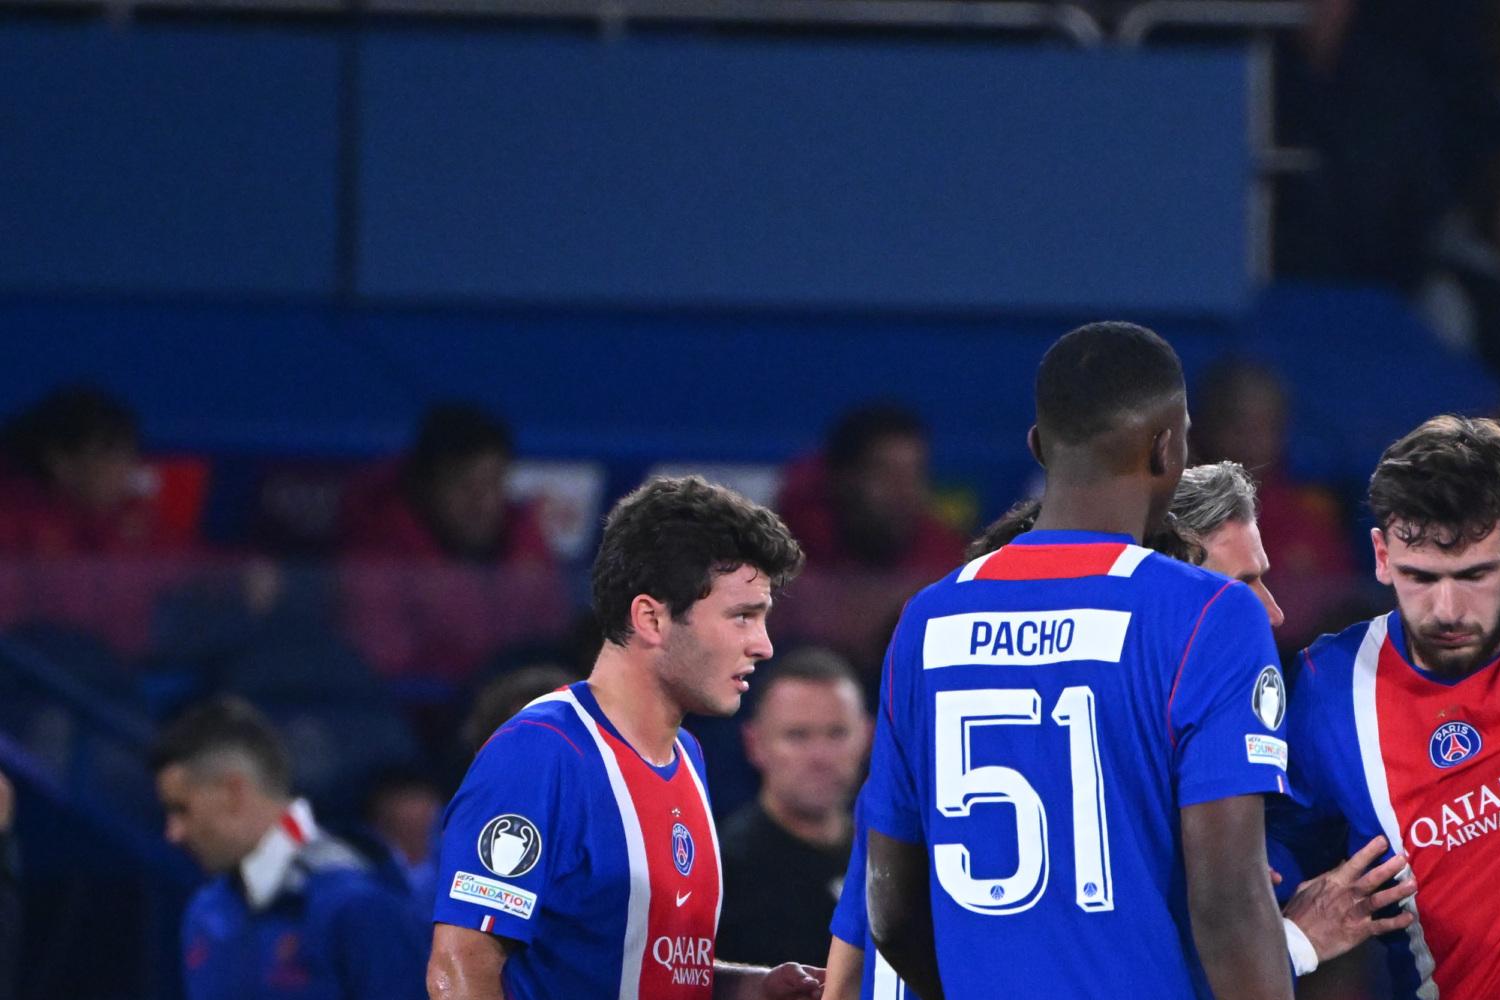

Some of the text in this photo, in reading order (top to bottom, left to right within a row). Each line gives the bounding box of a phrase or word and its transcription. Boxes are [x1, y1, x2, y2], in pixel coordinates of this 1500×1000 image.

[970, 618, 1075, 656] PACHO
[1435, 725, 1469, 741] PARIS
[934, 686, 1114, 915] 51
[454, 880, 532, 910] FOUNDATION
